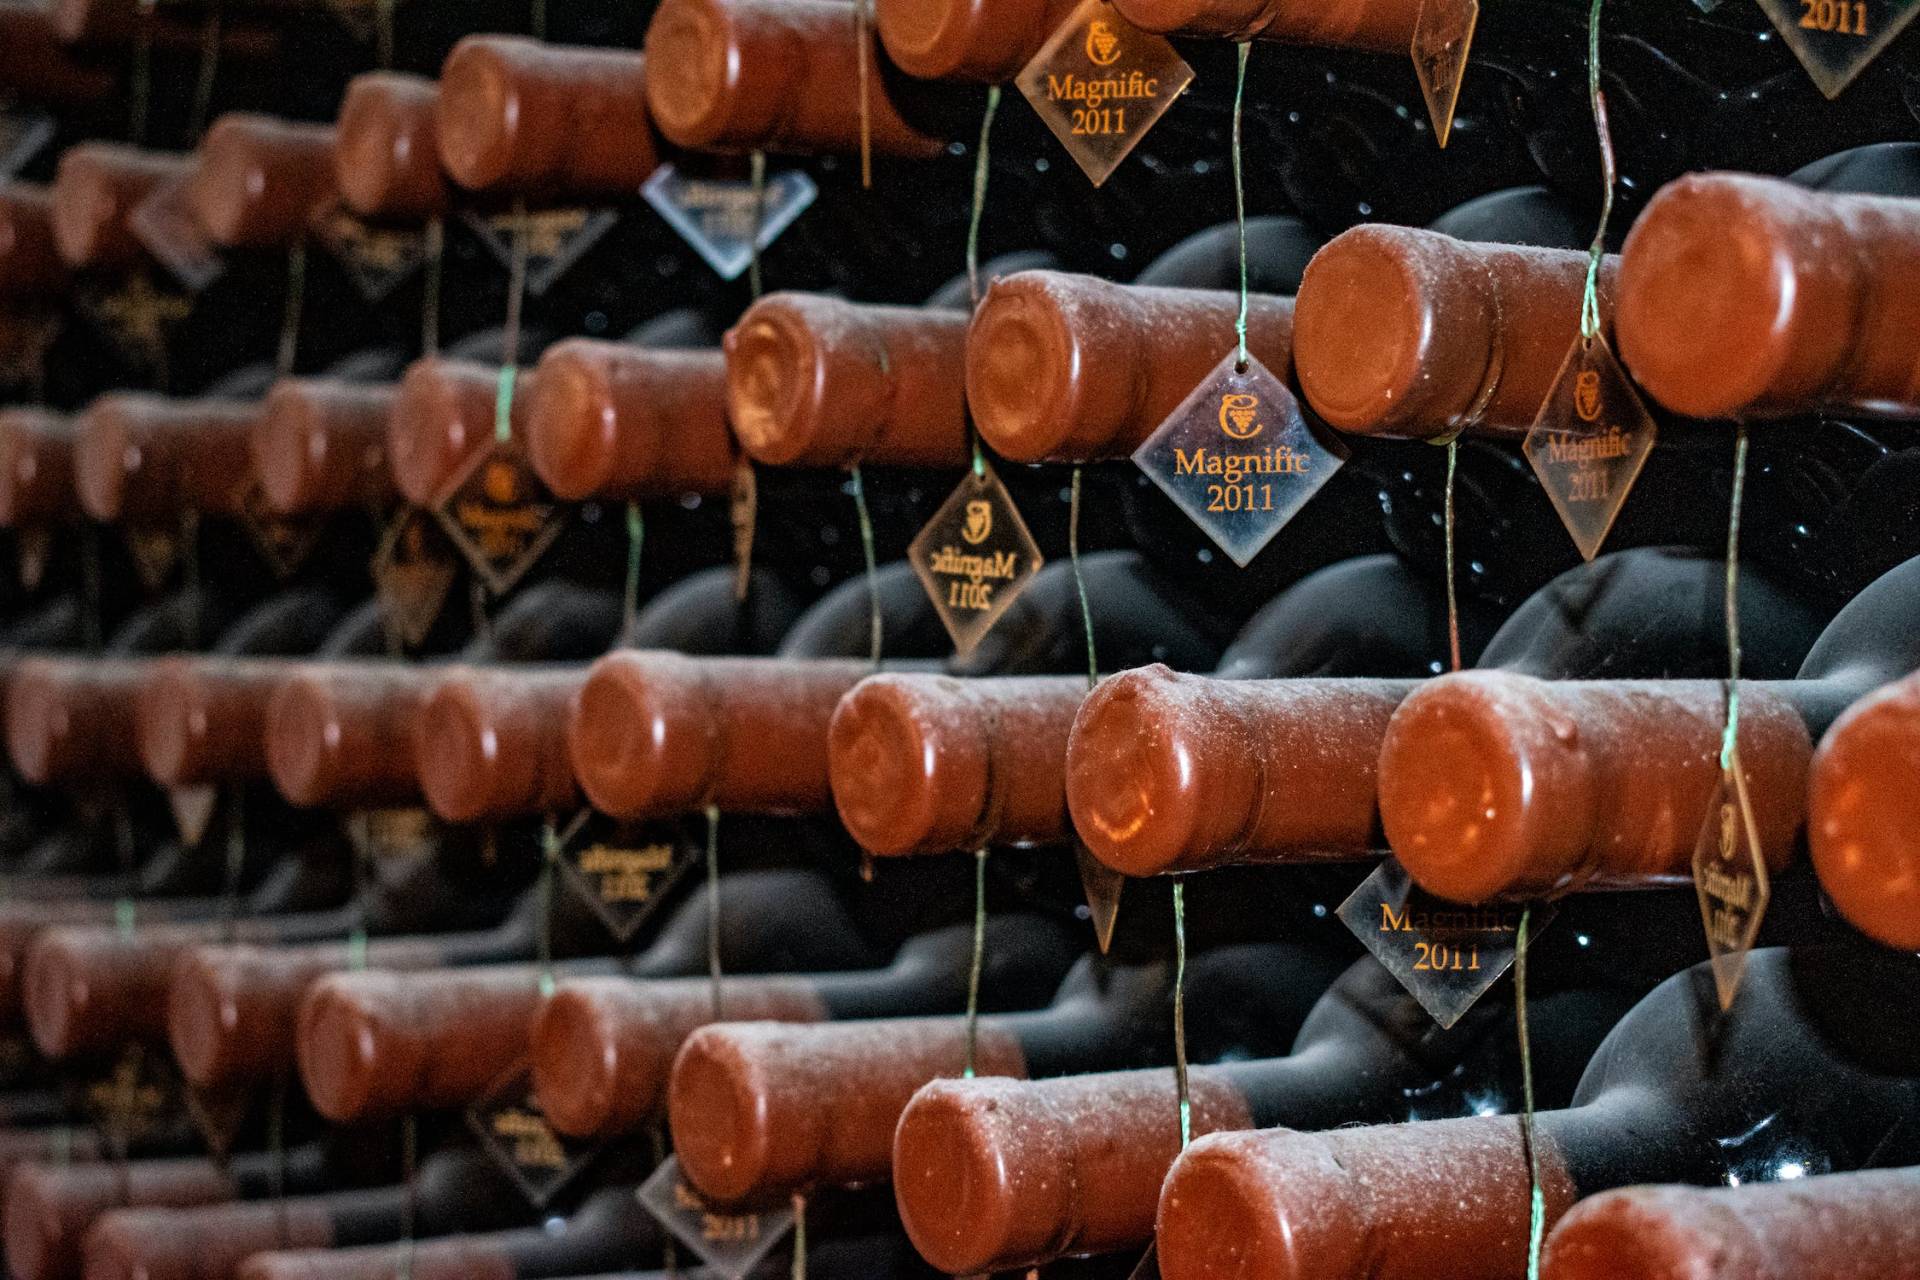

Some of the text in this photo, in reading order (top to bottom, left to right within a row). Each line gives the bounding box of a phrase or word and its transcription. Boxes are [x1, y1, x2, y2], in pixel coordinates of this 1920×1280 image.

[1798, 0, 1867, 36] 2011
[1048, 70, 1158, 108] Magnific
[1071, 108, 1126, 135] 2011
[1173, 445, 1311, 484] Magnific
[1549, 426, 1633, 470] Magnific
[1207, 484, 1274, 512] 2011
[1413, 942, 1481, 970] 2011
